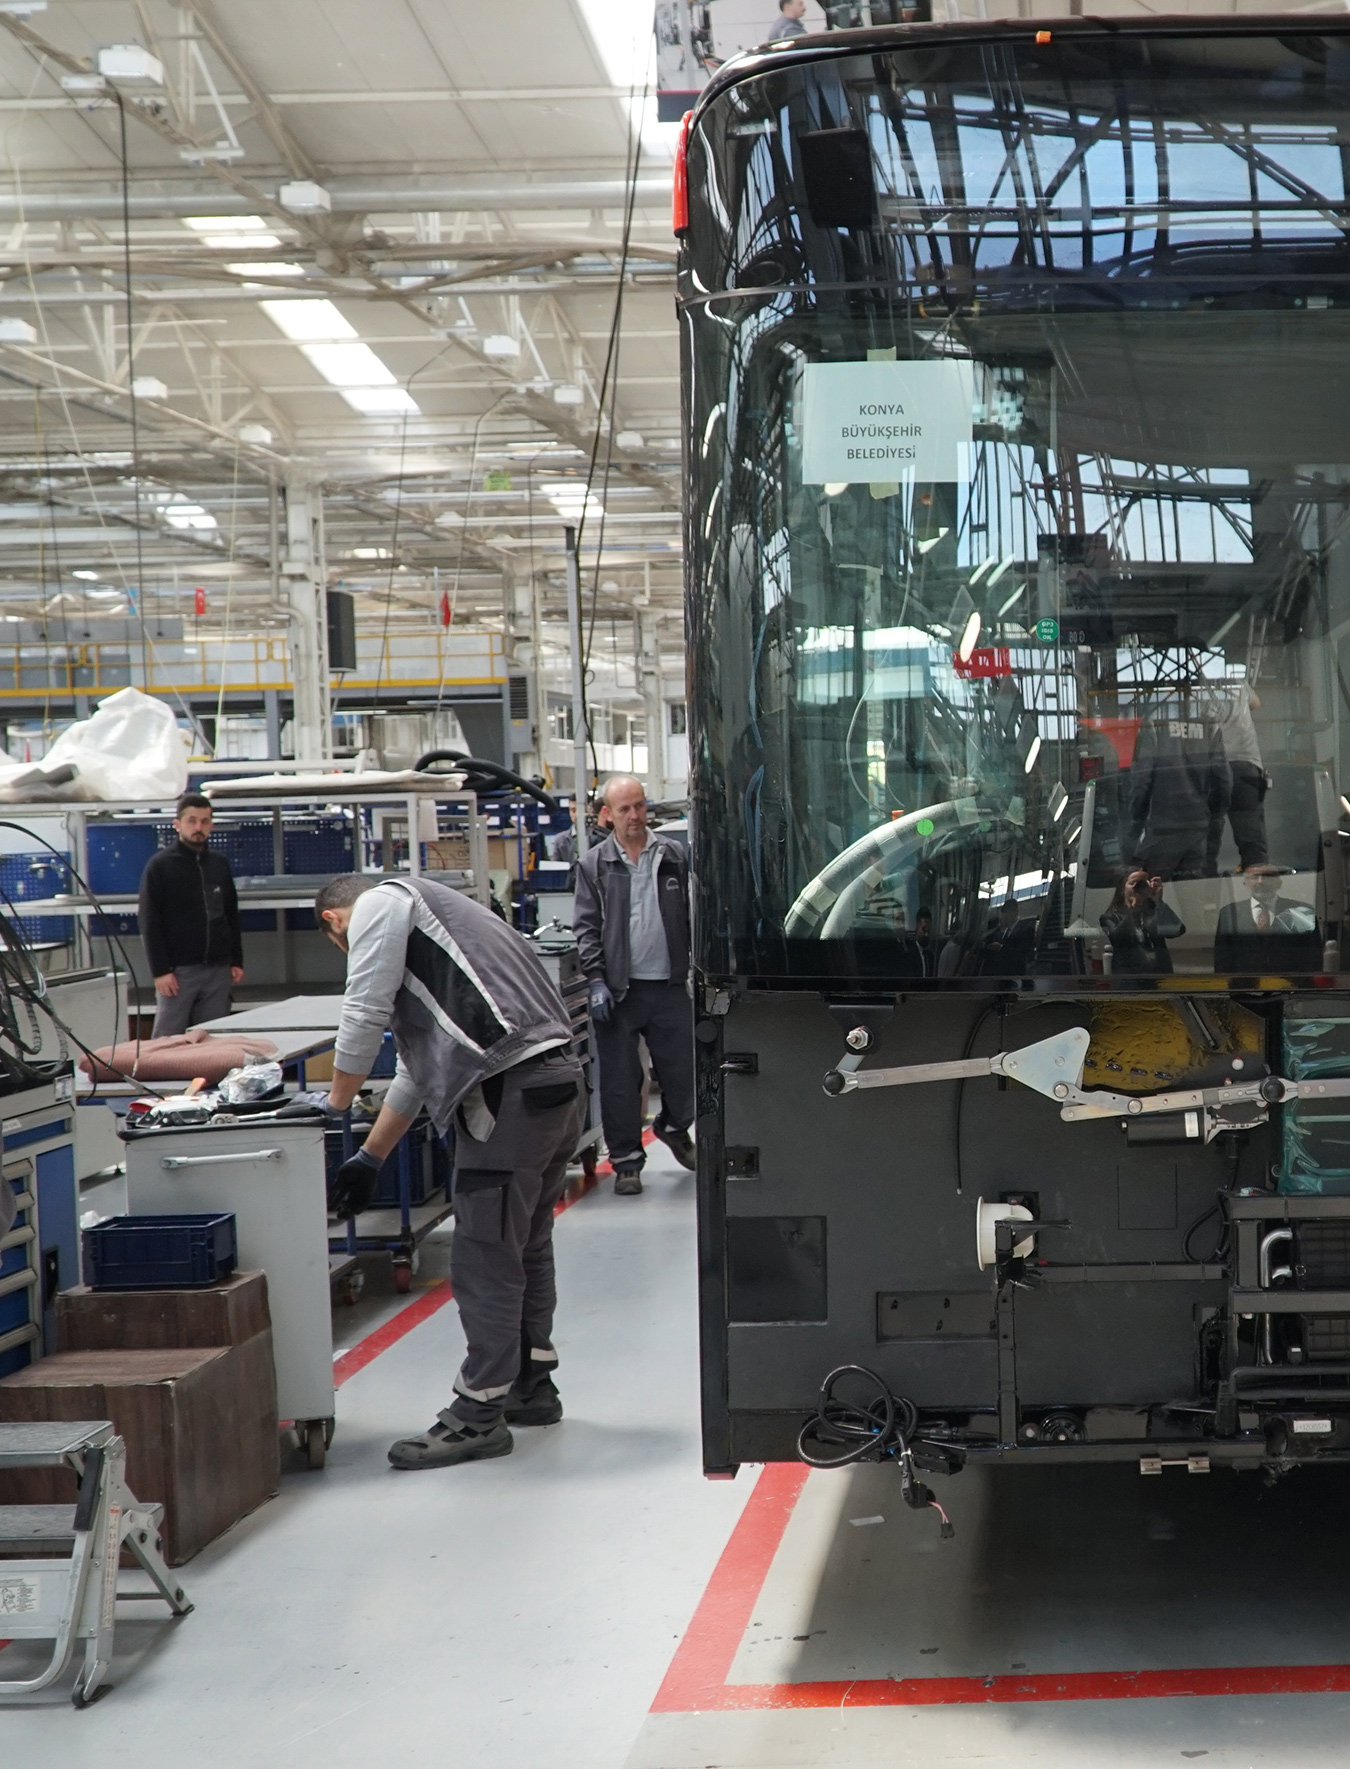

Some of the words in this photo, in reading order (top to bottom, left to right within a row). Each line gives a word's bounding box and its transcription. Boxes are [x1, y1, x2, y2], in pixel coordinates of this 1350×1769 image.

[859, 404, 905, 416] KONYA
[841, 423, 922, 440] BÜYÜKŞEHİR
[846, 445, 917, 460] BELEDİYESİ
